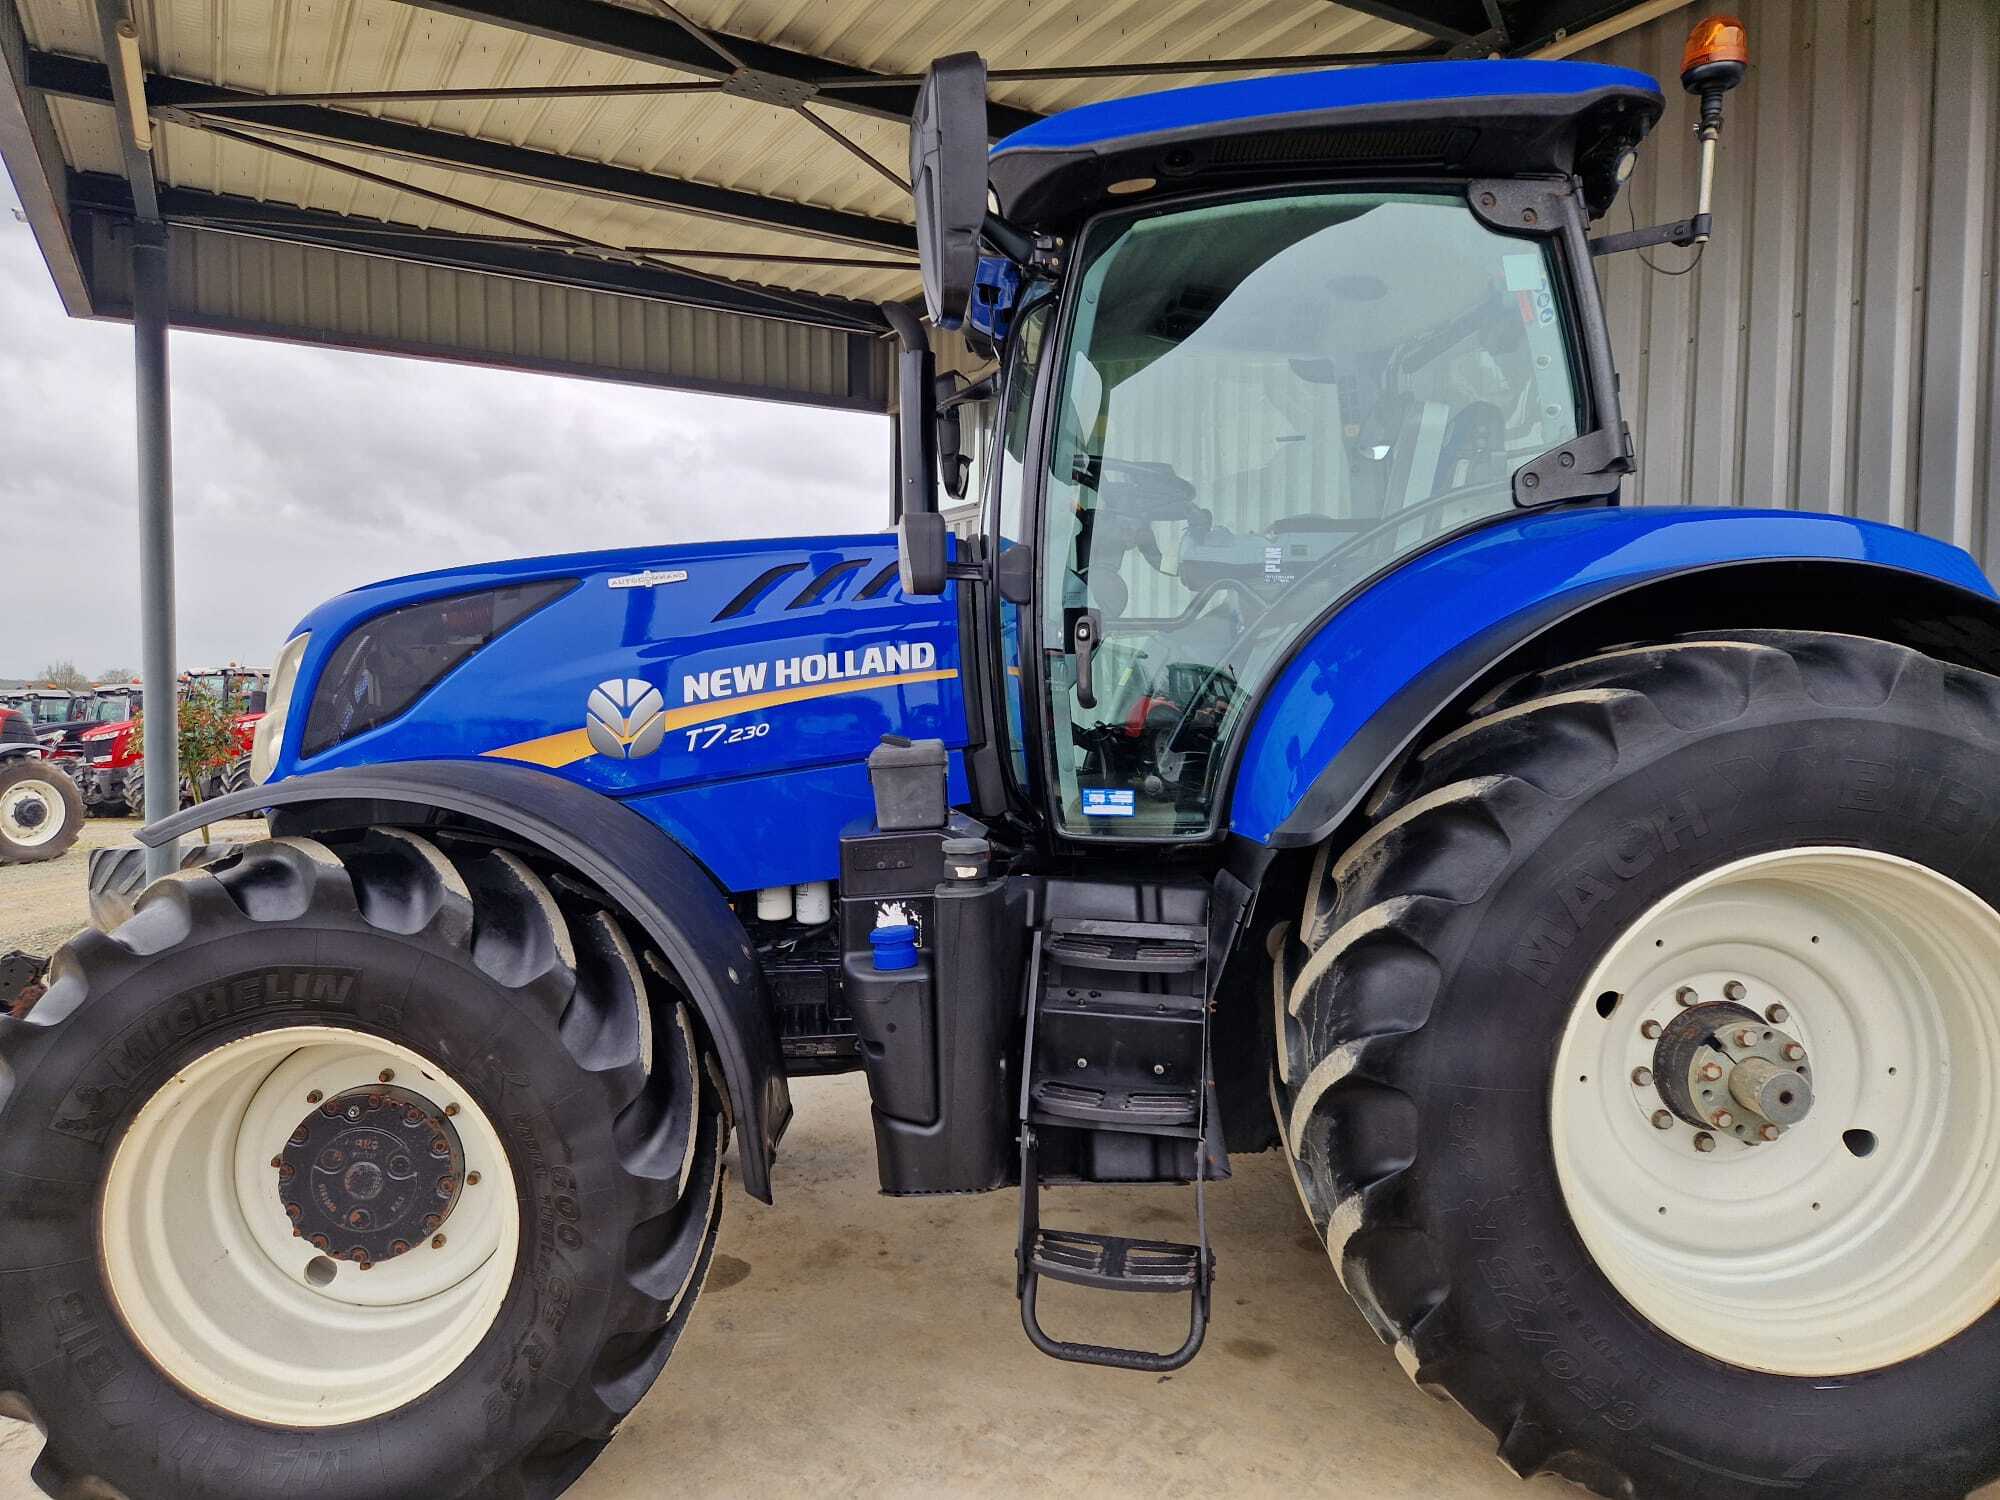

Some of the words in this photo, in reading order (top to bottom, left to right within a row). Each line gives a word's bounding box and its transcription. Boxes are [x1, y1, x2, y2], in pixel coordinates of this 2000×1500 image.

[684, 662, 767, 703] NEW
[775, 642, 934, 686] HOLLAND
[687, 723, 769, 751] T7.230
[107, 974, 352, 1082] MICHELIN
